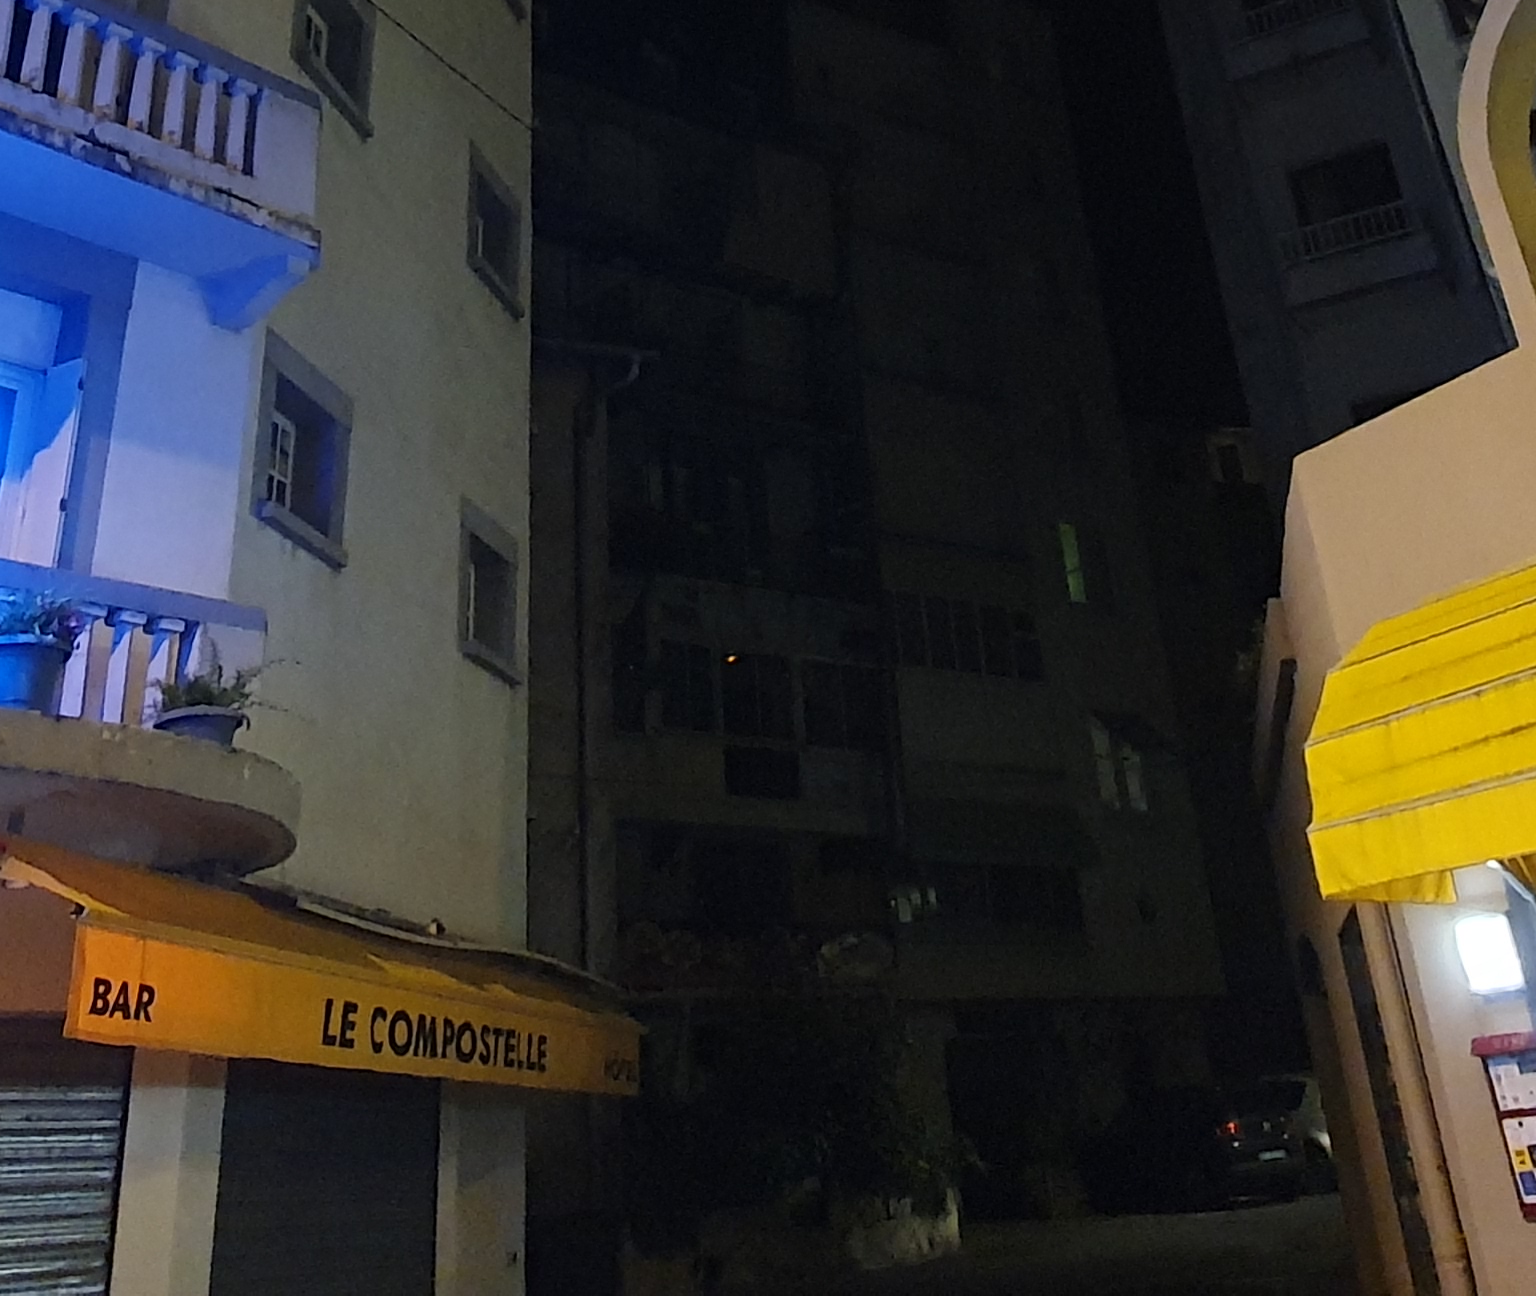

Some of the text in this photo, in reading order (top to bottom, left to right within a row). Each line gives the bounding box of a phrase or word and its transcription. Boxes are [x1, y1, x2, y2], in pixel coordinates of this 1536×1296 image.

[88, 976, 157, 1024] BAR
[321, 997, 549, 1074] LE COMPOSTELLE
